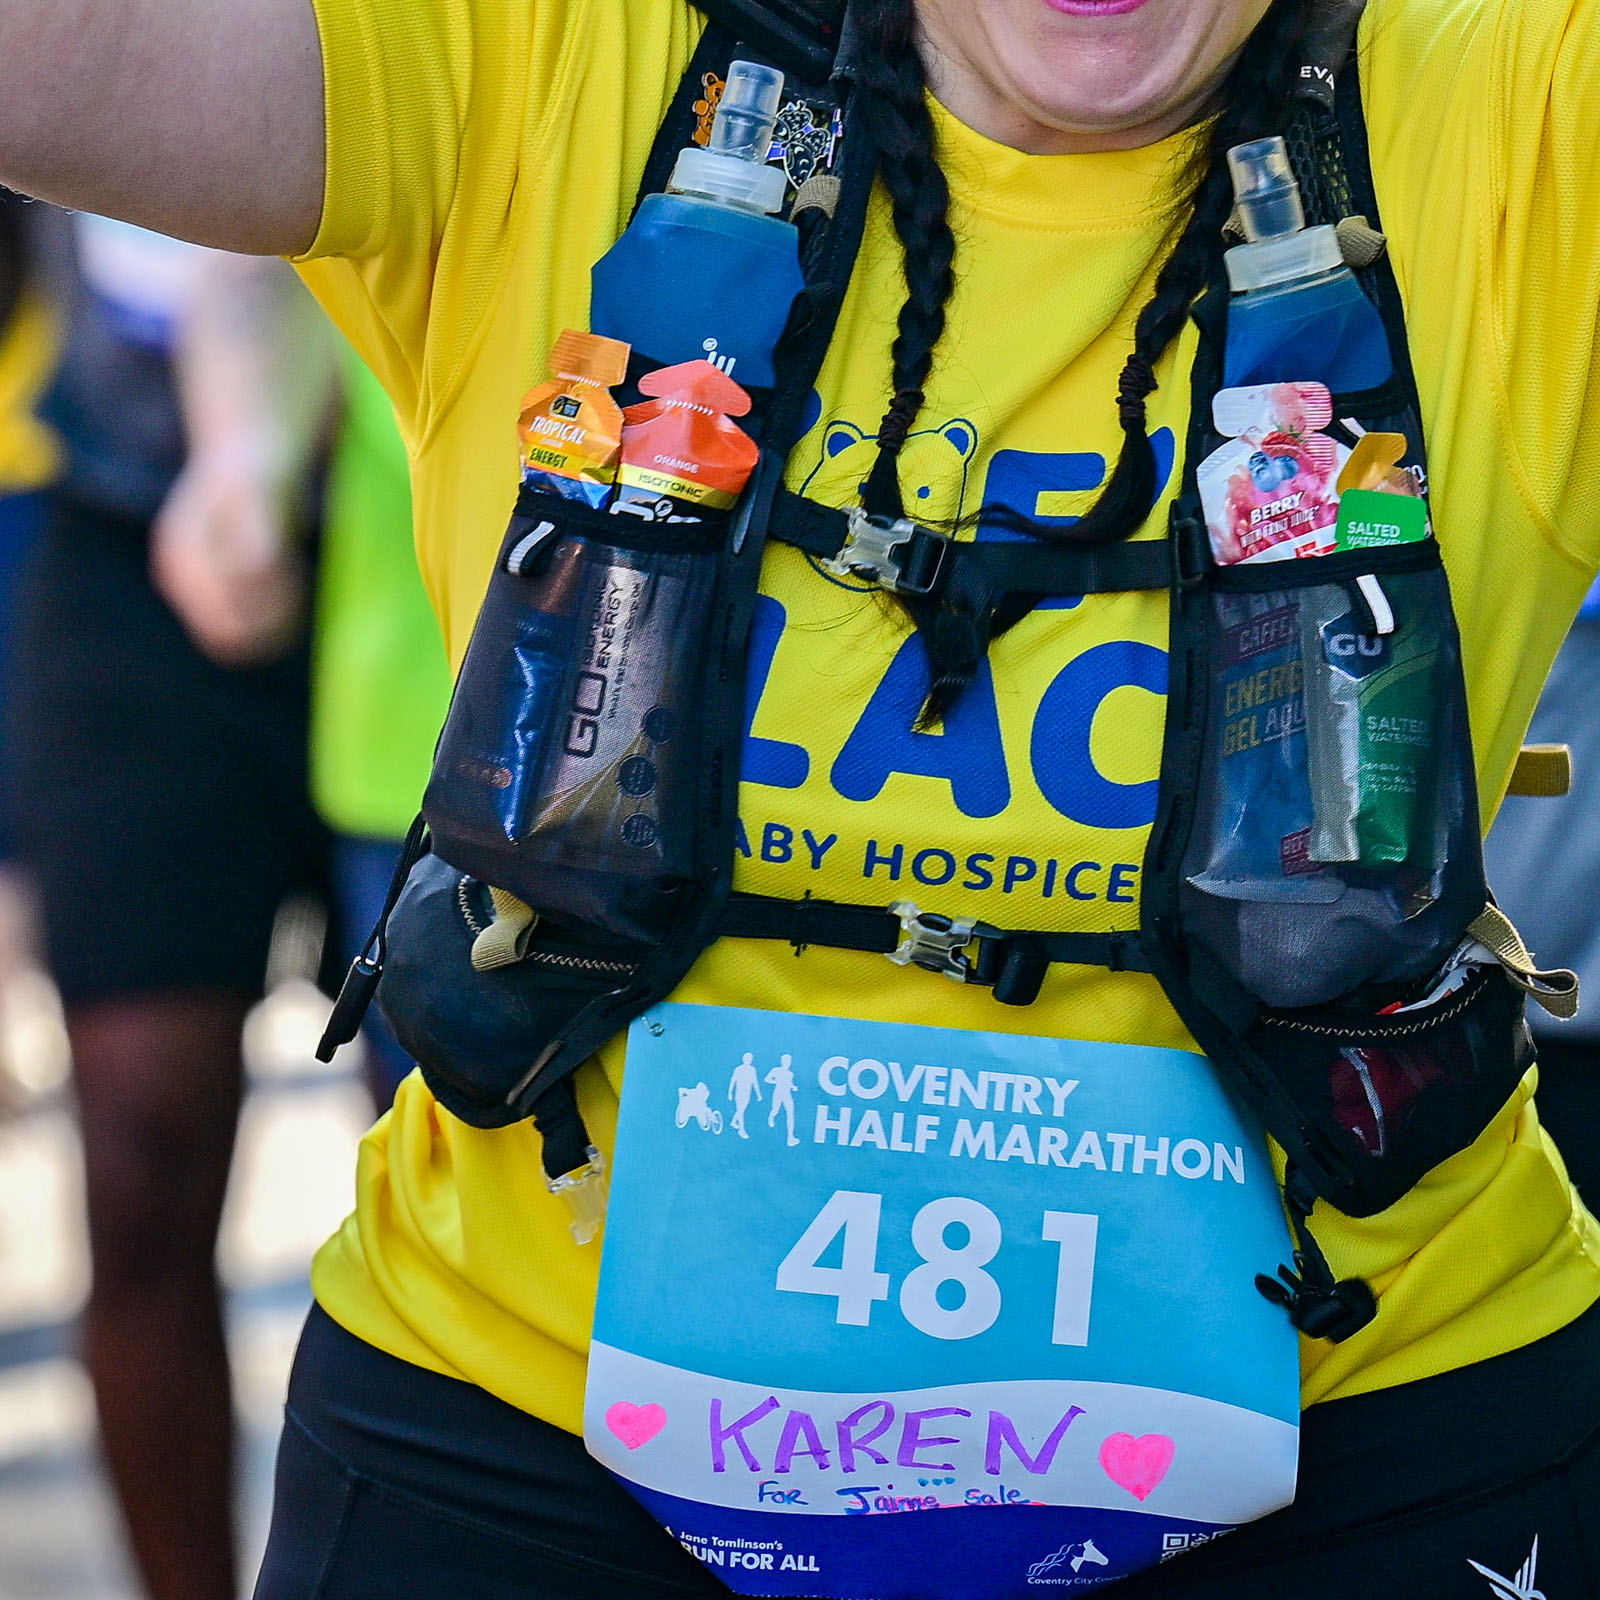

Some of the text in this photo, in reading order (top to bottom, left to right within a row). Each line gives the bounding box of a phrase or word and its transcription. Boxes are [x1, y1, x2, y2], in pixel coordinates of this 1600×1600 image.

[528, 415, 589, 446] TROPICAL
[529, 447, 568, 469] ENERGY
[653, 454, 700, 474] ORANGE
[638, 473, 703, 499] ISOTONIC
[1250, 491, 1304, 525] BERRY
[1347, 521, 1401, 538] SALTED
[596, 580, 625, 669] ENERGY
[1329, 633, 1383, 657] GU
[563, 669, 608, 758] GO
[863, 838, 1141, 903] HOSPICE
[817, 1055, 1080, 1119] COVENTRY
[812, 1104, 1247, 1186] HALF MARATHON
[775, 1189, 1100, 1348] 481
[709, 1395, 1088, 1475] KAREN
[679, 1531, 784, 1551] Jane Tomlinson's
[729, 1551, 774, 1571] FOR
[779, 1554, 820, 1573] ALL
[1027, 1576, 1073, 1586] Coventry
[1074, 1577, 1093, 1586] City
